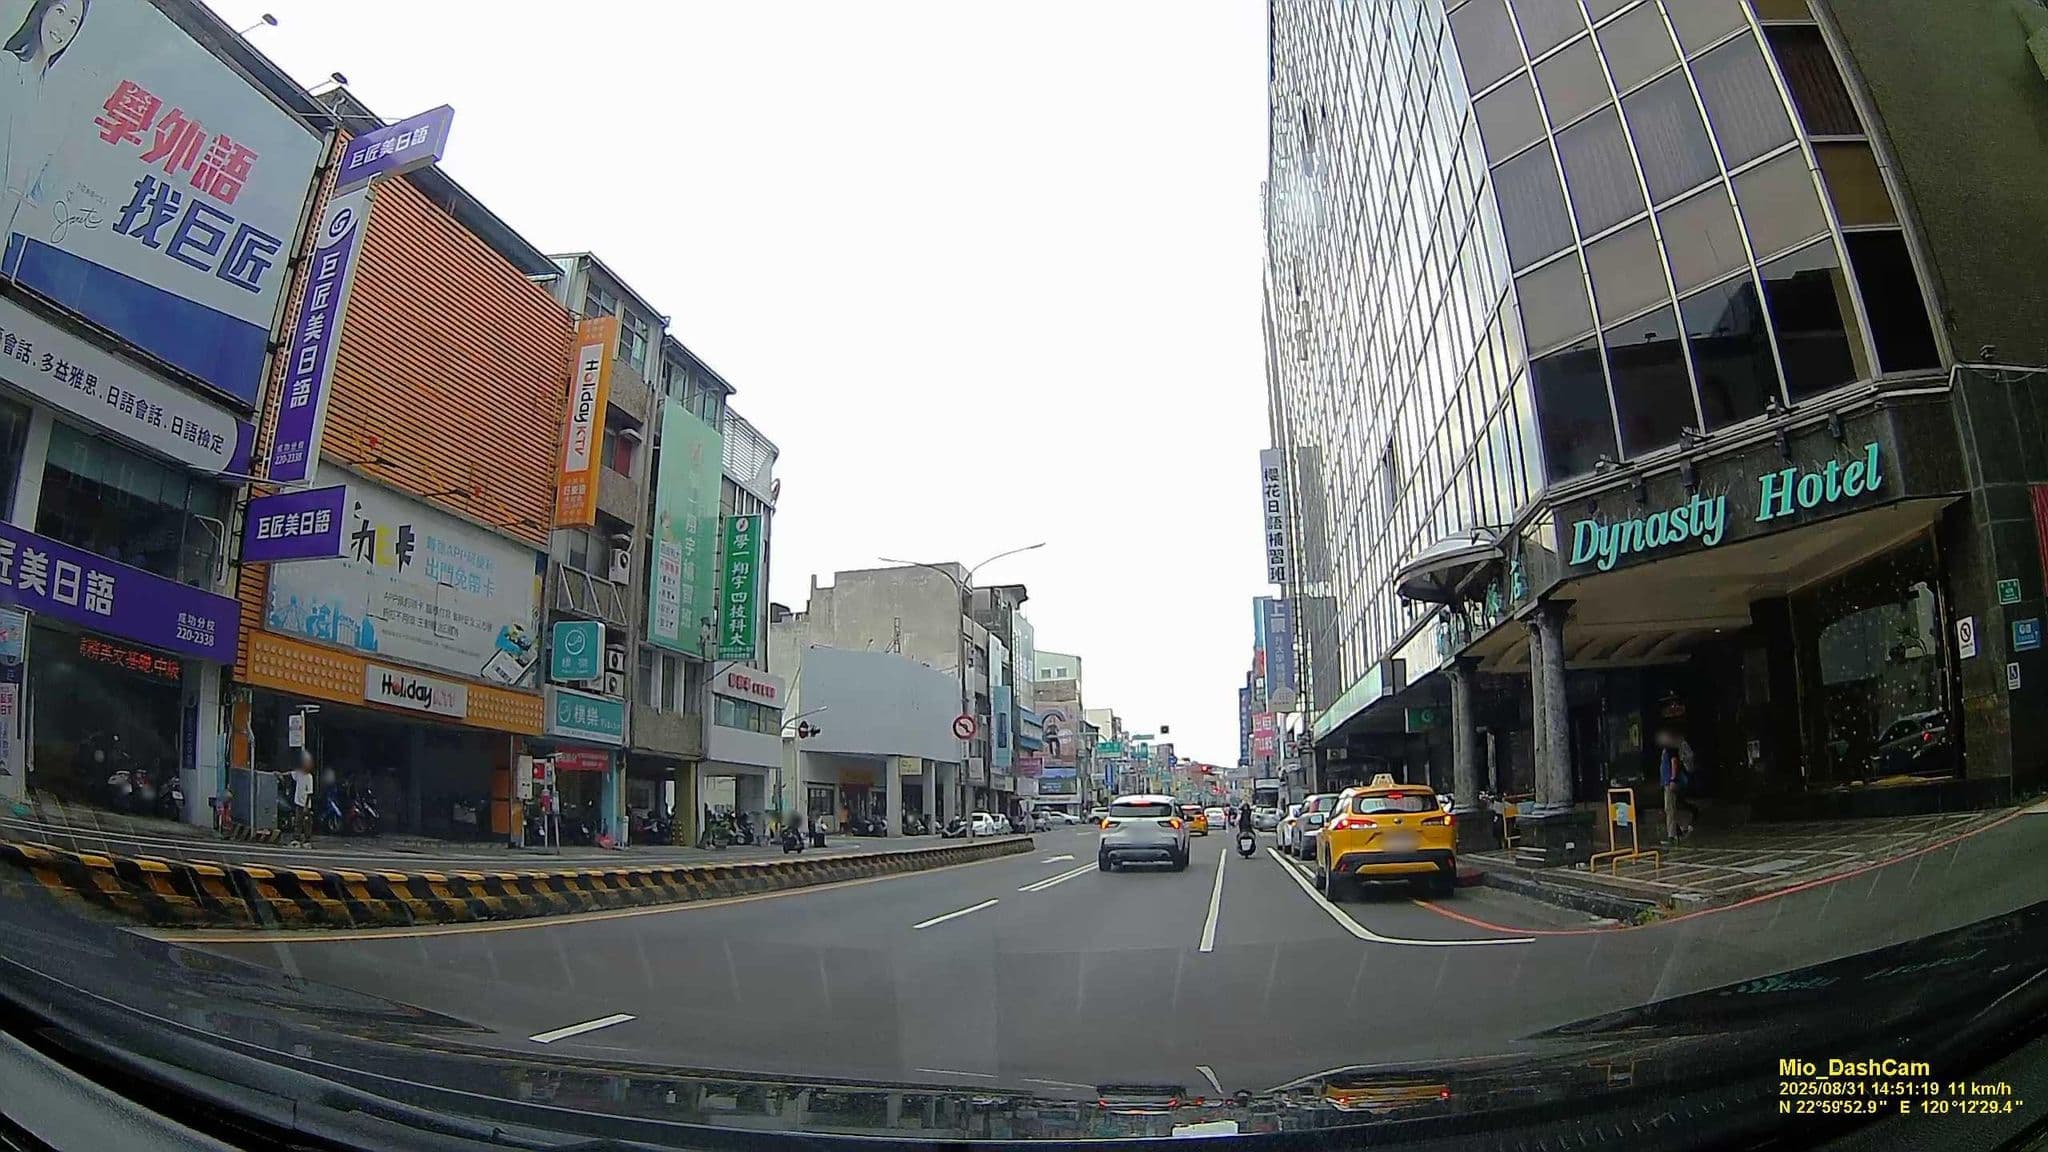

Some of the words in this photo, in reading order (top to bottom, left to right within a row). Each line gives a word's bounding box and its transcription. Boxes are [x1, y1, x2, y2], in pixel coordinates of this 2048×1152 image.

[94, 78, 259, 205] 學外語
[347, 124, 430, 171] 巨匠美日語
[112, 173, 283, 295] 找巨匠
[289, 252, 342, 410] 巨匠美日語
[573, 359, 599, 424] Holiday
[257, 509, 332, 540] 巨匠美日語
[1569, 494, 1728, 572] Dynasty
[1755, 441, 1882, 523] Hotel
[176, 626, 215, 647] 220-2338
[178, 612, 216, 632] 成功分校
[381, 673, 433, 708] Holiday
